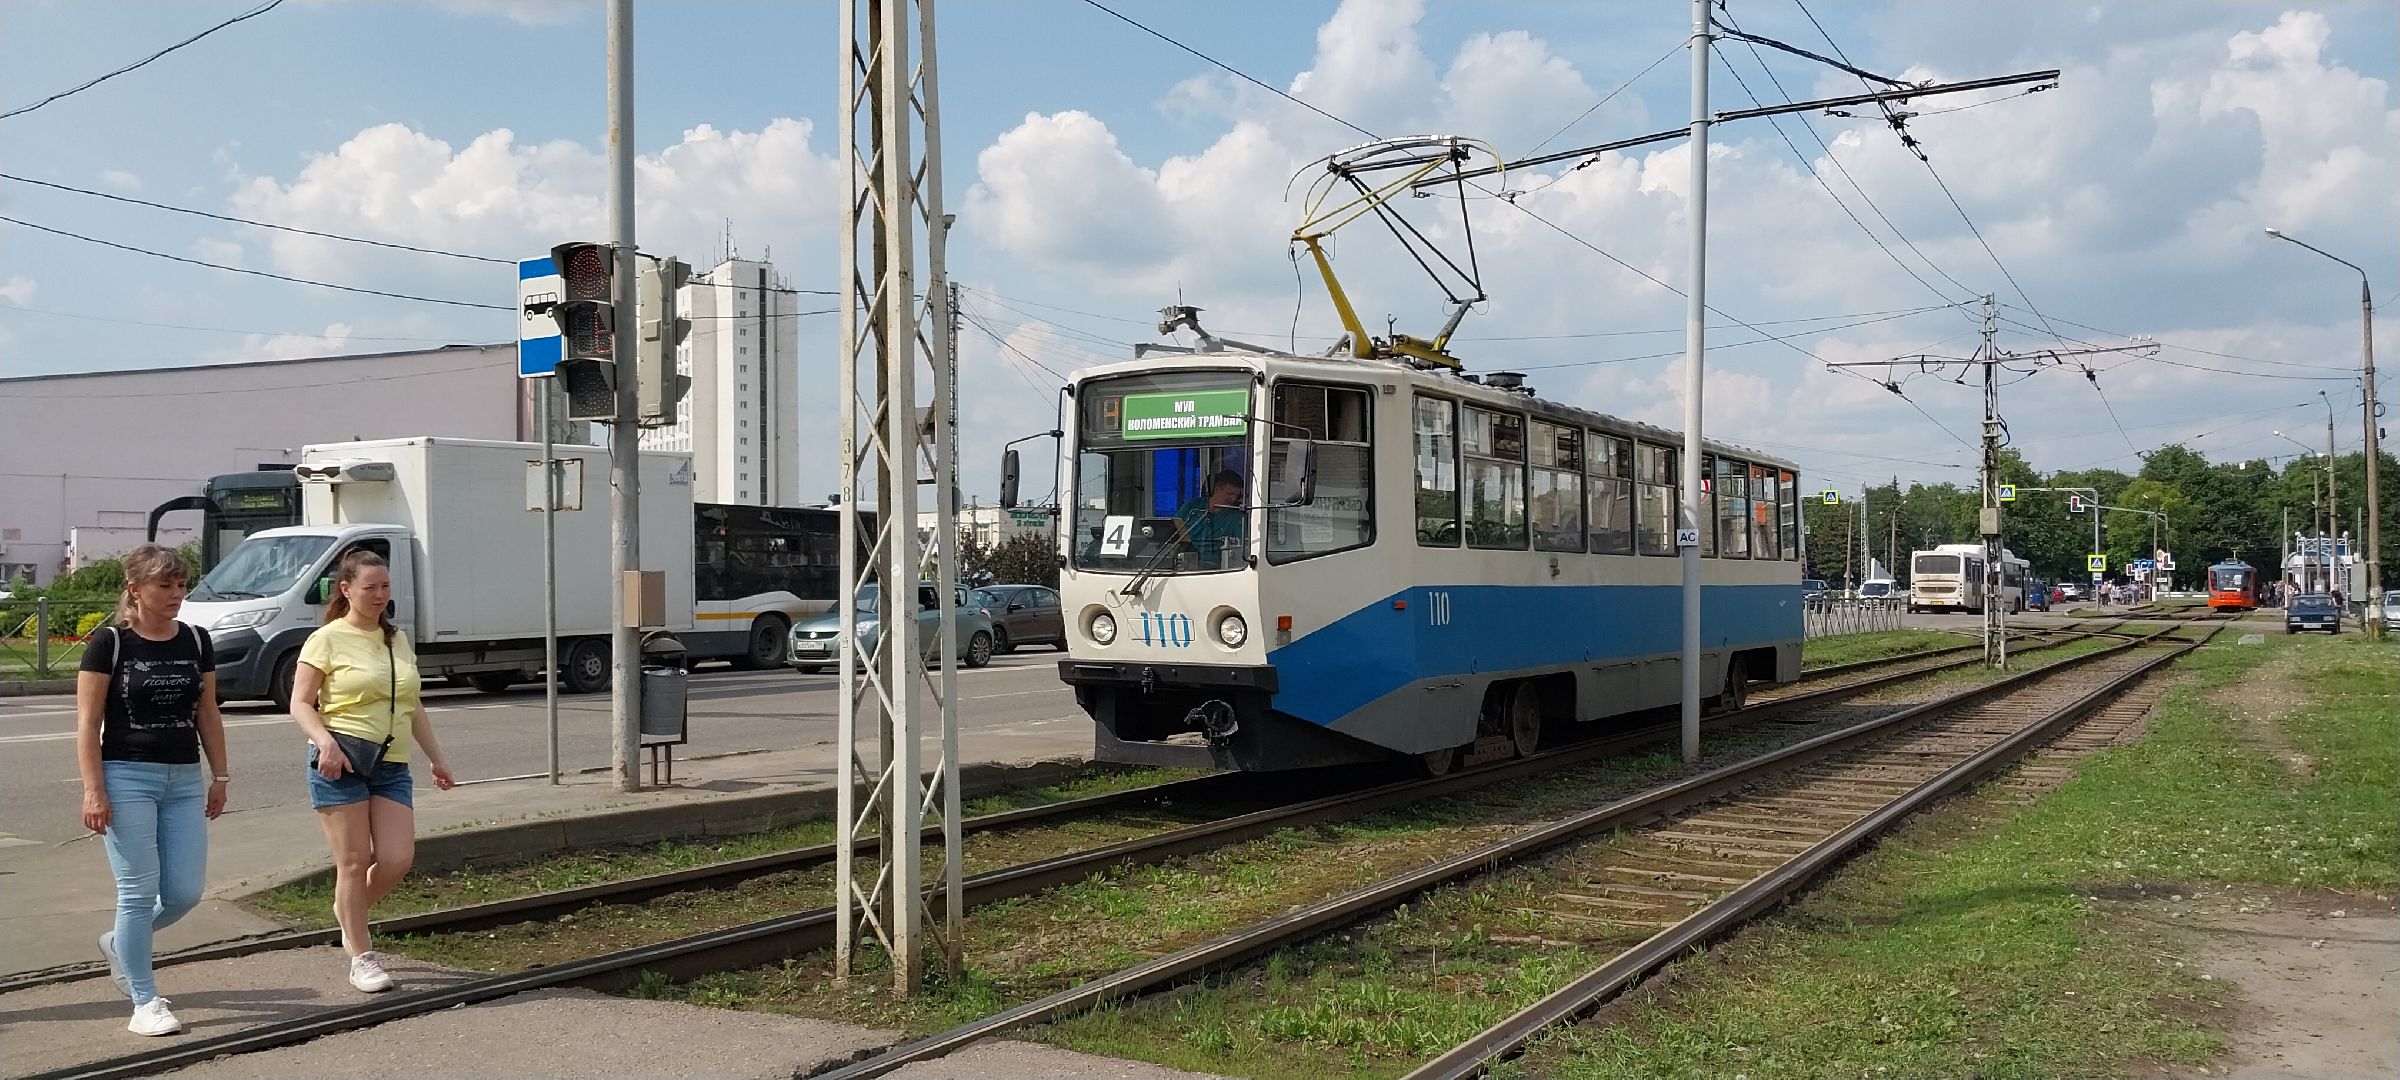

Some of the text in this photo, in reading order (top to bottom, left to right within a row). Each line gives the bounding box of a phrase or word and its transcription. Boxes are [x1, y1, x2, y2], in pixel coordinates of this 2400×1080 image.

[1174, 400, 1195, 413] МУП
[1127, 415, 1196, 431] КОЛОМЕНСКИЙ
[1106, 525, 1125, 550] 4
[1680, 532, 1696, 542] АС
[1429, 591, 1450, 626] 110
[1141, 612, 1191, 647] 110
[142, 677, 191, 687] FLOWERS
